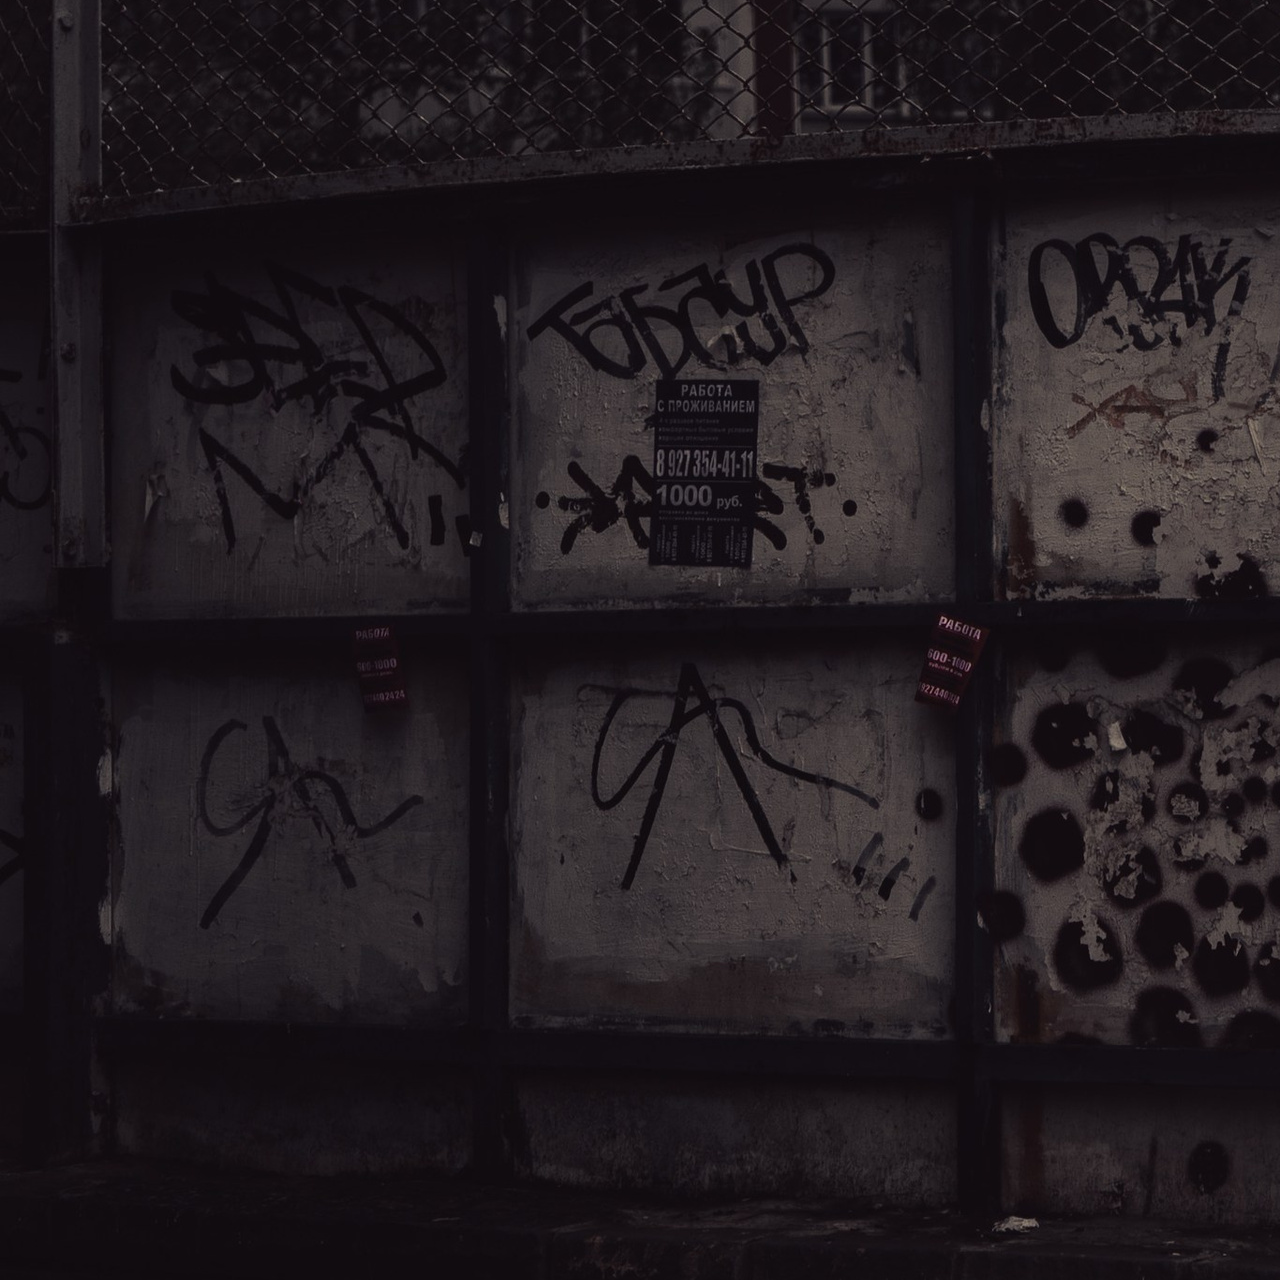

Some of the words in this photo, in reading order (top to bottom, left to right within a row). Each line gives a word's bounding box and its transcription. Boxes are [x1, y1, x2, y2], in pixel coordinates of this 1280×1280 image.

[681, 384, 733, 397] РАБОТА
[657, 399, 665, 413] С
[668, 399, 755, 414] ПРОЖИВАНИЕМ
[656, 449, 665, 477] 8
[668, 449, 691, 477] 927
[693, 450, 754, 478] 354-41-11
[656, 484, 713, 507] 1000
[716, 495, 743, 510] руб.
[355, 627, 390, 640] РАБОТА
[938, 615, 982, 640] РАБОТА
